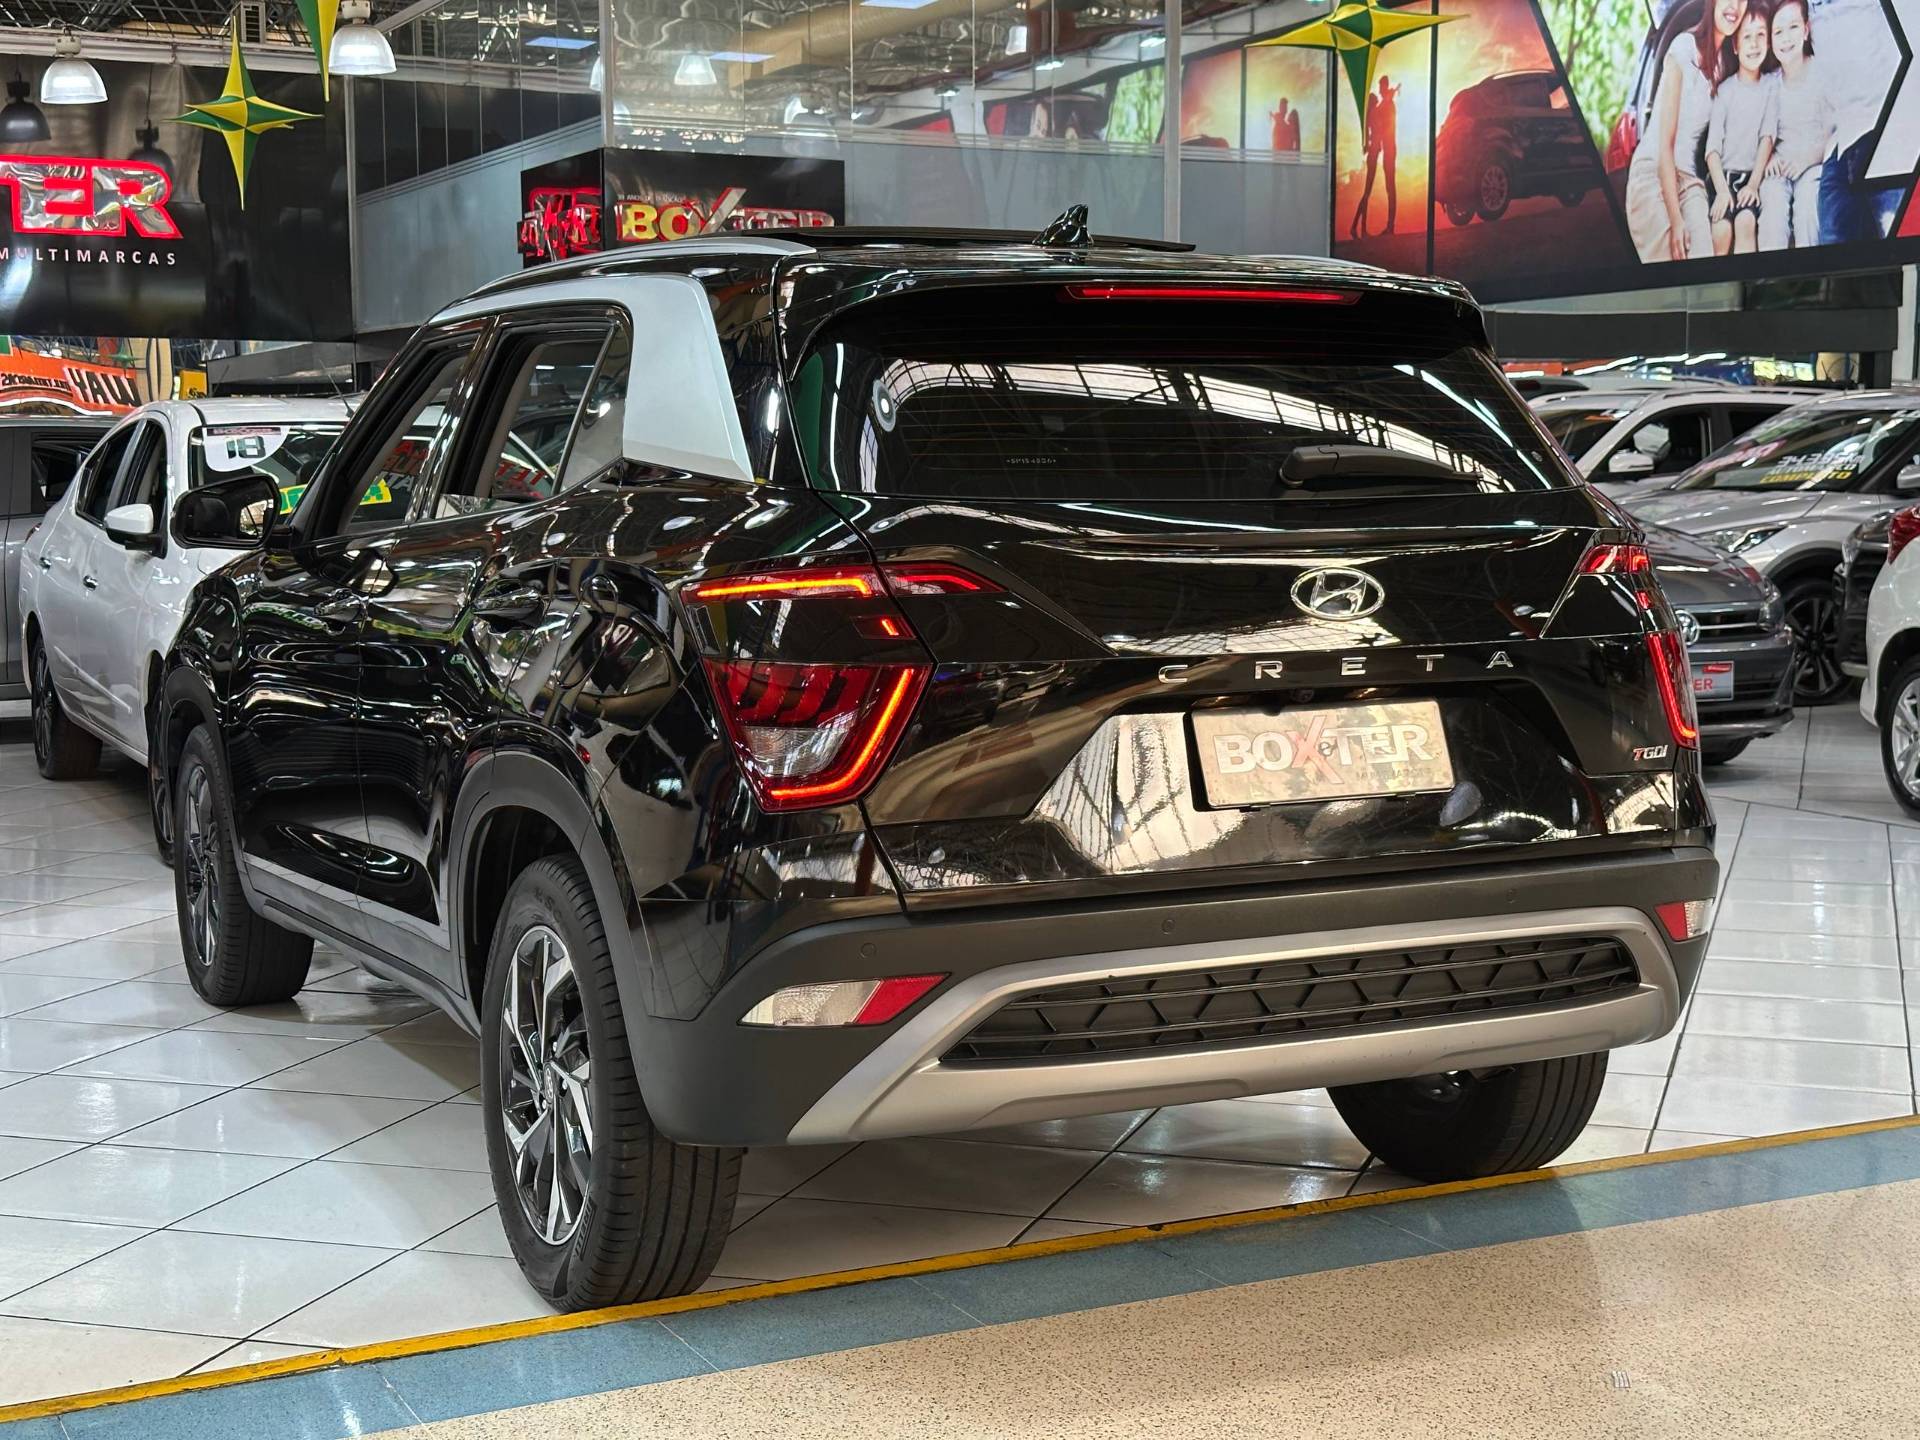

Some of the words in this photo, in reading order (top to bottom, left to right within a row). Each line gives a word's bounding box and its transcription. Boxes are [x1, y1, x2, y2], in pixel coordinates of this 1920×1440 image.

[1158, 651, 1514, 684] CRETA
[1213, 714, 1434, 784] BOXTER
[1633, 744, 1669, 761] TGDI
